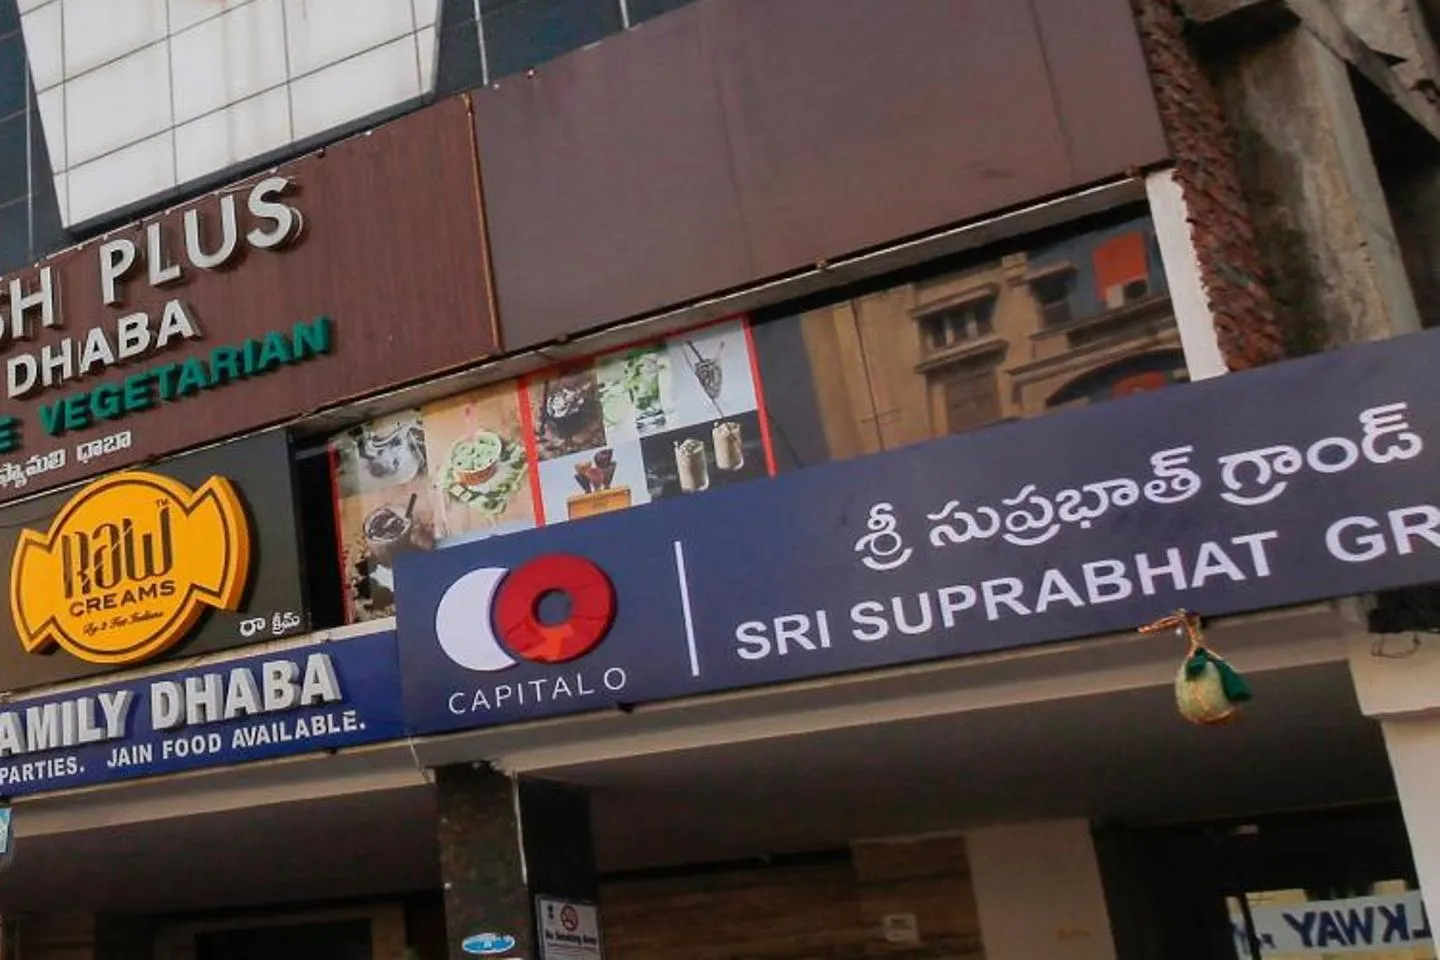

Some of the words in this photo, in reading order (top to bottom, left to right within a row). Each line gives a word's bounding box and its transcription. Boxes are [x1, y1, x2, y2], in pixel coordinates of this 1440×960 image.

[100, 176, 305, 305] PLUS
[5, 299, 203, 399] DHABA
[38, 316, 333, 438] VEGETARIAN
[854, 501, 914, 572] శ్రీ
[927, 445, 1202, 548] సుప్రభాత్
[1217, 401, 1424, 506] గ్రాండ్
[67, 579, 177, 618] CREAMS
[733, 607, 833, 662] SRI
[851, 530, 1280, 641] SUPRABHAT
[106, 741, 154, 769] JAIN
[161, 733, 222, 760] FOOD
[231, 710, 367, 749] AVAILABLE.
[151, 652, 342, 732] DHABA
[447, 671, 596, 716] CAPITAL
[603, 666, 627, 691] O
